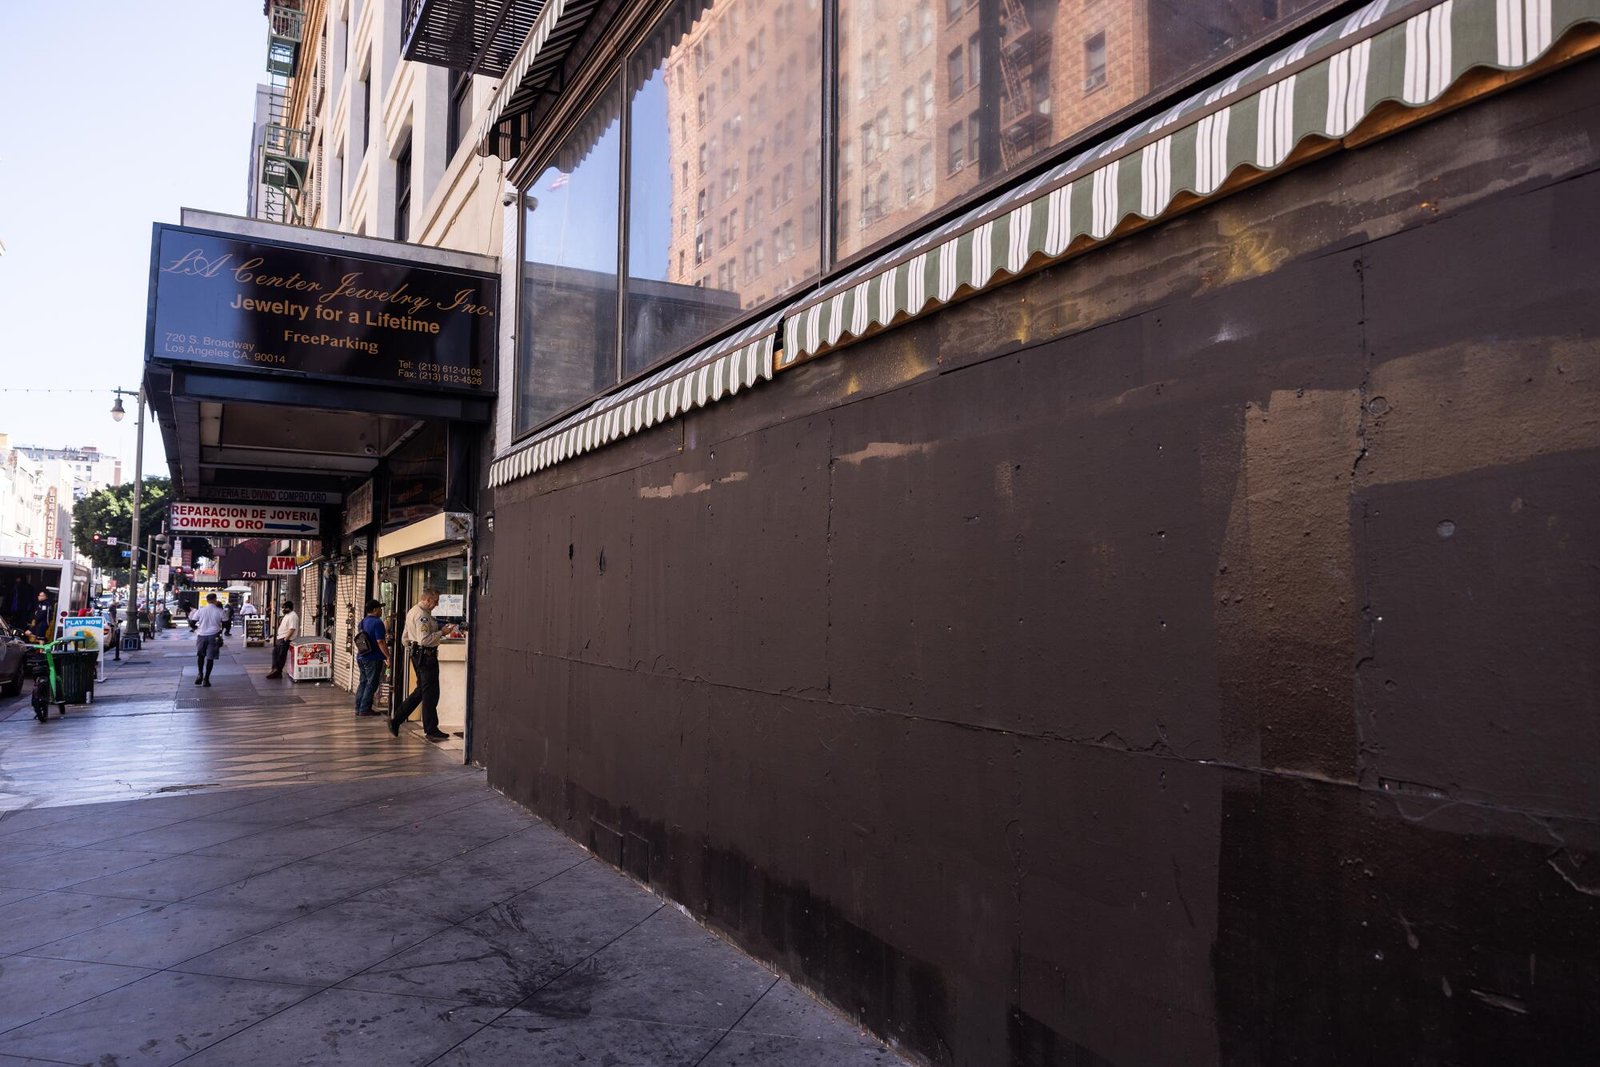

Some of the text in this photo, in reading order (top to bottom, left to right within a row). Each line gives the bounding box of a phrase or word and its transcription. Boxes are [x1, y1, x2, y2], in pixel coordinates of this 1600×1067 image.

[160, 249, 493, 317] LA Center Jewelry Inc.
[230, 294, 440, 334] Jewelry for a Lifetime
[166, 332, 255, 352] 720 S. Broadway
[165, 343, 184, 354] Los
[187, 345, 230, 358] Angeles
[254, 352, 286, 363] 90014
[398, 359, 482, 377] Tel: (213) 612-0106
[398, 368, 482, 386] Fax: (213) 612-4526
[278, 490, 309, 502] COMPRO
[310, 493, 327, 503] ORO
[171, 504, 318, 522] REPARACION DE JOYERIA
[171, 516, 264, 530] COMPRO ORO
[269, 557, 296, 570] ATM
